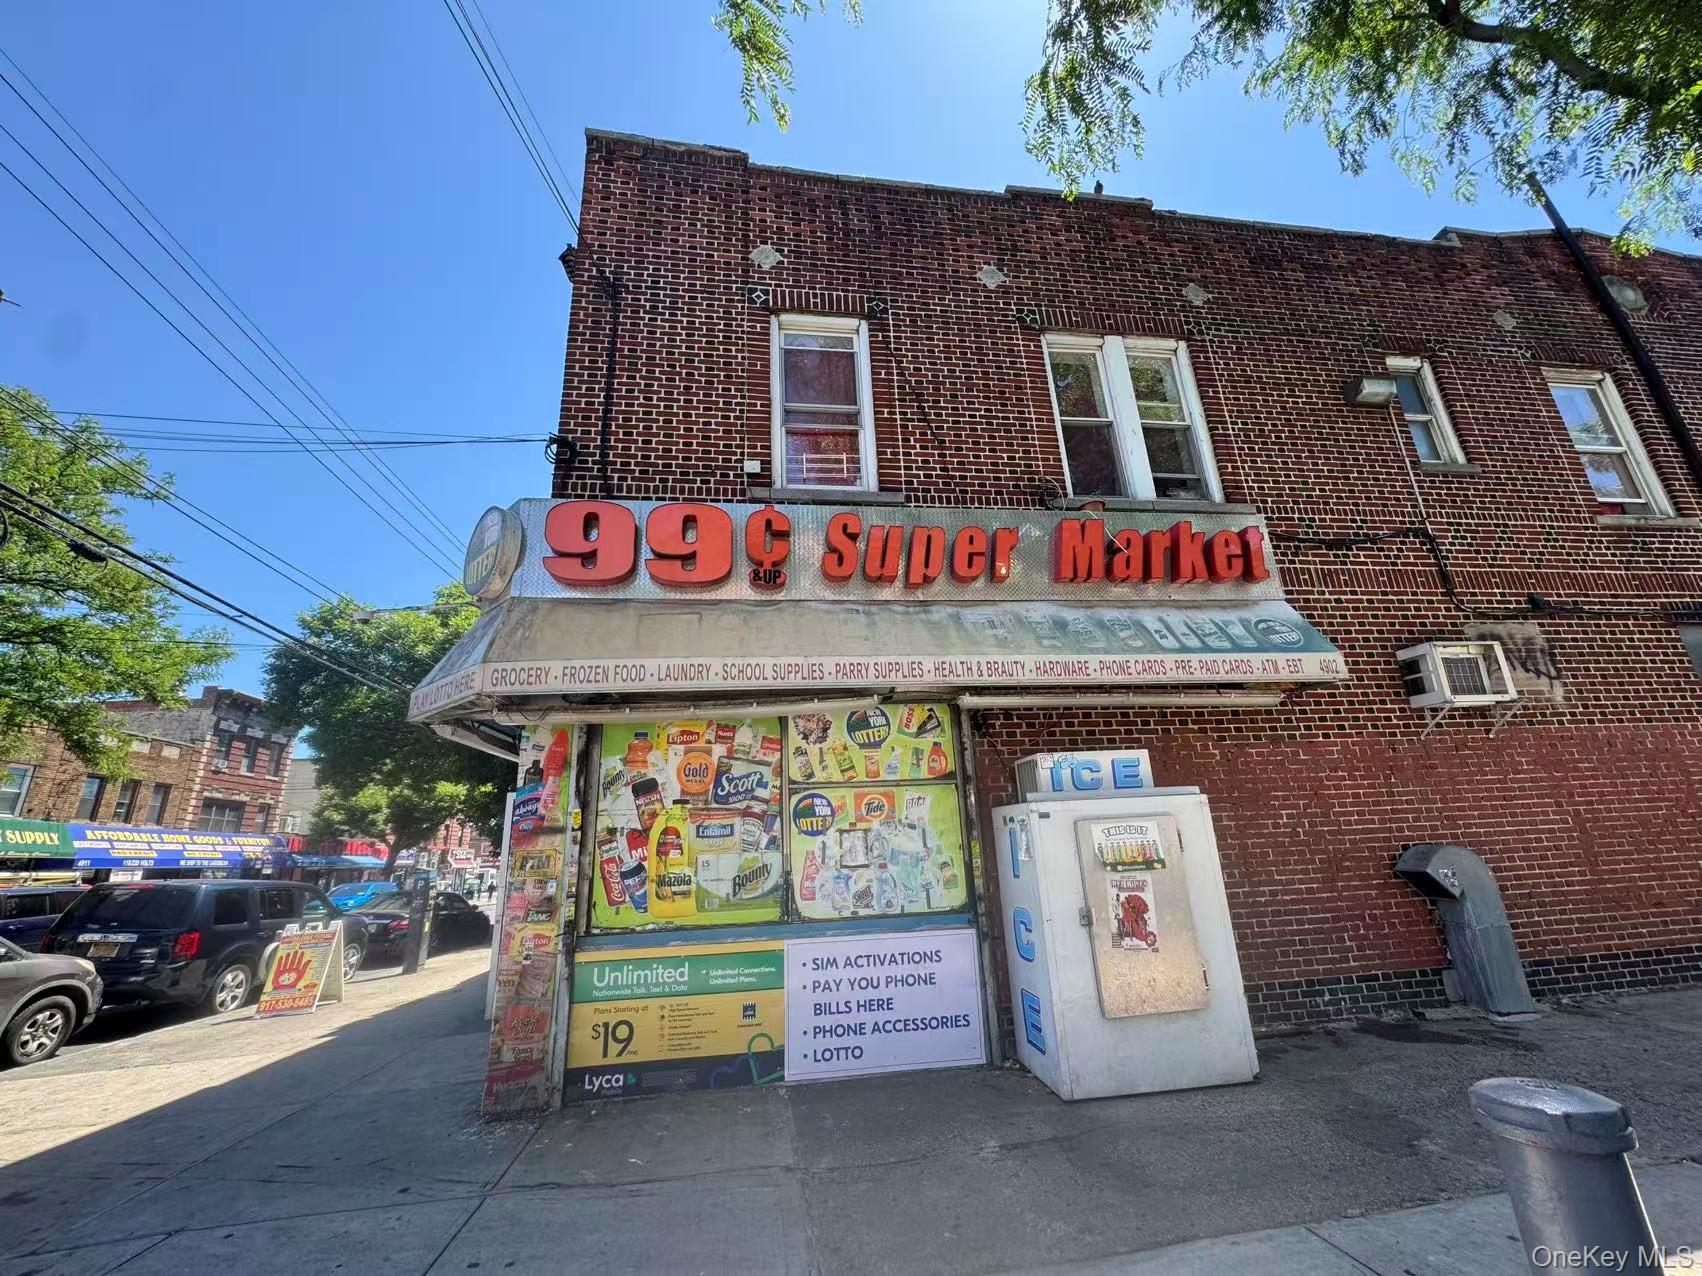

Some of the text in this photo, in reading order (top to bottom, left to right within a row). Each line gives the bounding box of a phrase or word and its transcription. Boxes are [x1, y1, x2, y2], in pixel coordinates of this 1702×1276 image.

[822, 512, 1271, 589] Super Market
[752, 568, 782, 585] &UP
[491, 666, 551, 687] GROCERY
[561, 665, 610, 684] FROZEN
[613, 664, 646, 682] FOOD
[657, 663, 712, 681] LAUNDRY
[722, 663, 768, 681] SCHOOL
[772, 662, 825, 680] SUPPLIES
[835, 662, 870, 680] PARRY
[873, 661, 924, 679] SUPPLIES
[933, 661, 973, 677] HEALTH
[976, 661, 984, 677] &
[986, 661, 1025, 677] BRAUTY
[1034, 660, 1091, 677] HARDWARE
[1099, 660, 1132, 676] PHONE
[1134, 659, 1167, 675] CARDS
[1199, 659, 1220, 675] PAID
[1222, 659, 1254, 675] CARDS
[1261, 658, 1280, 675] ATM
[1286, 658, 1305, 674] EBT
[1319, 658, 1340, 674] 4902
[429, 682, 453, 705] LOTTO
[455, 670, 476, 693] HERE
[869, 716, 887, 727] YORK
[669, 733, 698, 744] Lipton
[851, 726, 889, 743] LOTTERY
[684, 762, 709, 778] Gold
[1052, 757, 1143, 792] ICE
[717, 772, 760, 796] Scott
[814, 798, 828, 806] NEW
[864, 801, 886, 816] Tide
[815, 806, 832, 816] YORK
[6, 830, 60, 845] SUPPLY
[85, 830, 161, 842] AFFORDABLE
[161, 833, 193, 844] HOME
[193, 835, 224, 845] GOODS
[231, 837, 273, 846] FURNITUR
[699, 826, 731, 836] Enfamil
[1102, 825, 1148, 837] THIS IS IT
[656, 872, 691, 887] Mazola
[732, 862, 773, 899] Bounty
[812, 950, 943, 971] SIM ACTIVATIONS
[593, 962, 689, 987] Unlimited
[709, 968, 739, 976] Unlimited
[709, 977, 739, 985] Unlimited
[812, 972, 936, 993] PAY YOU PHONE
[592, 988, 631, 997] Nationwide
[650, 985, 663, 993] Text
[671, 984, 688, 992] Data
[594, 1007, 612, 1015] Plans
[614, 1005, 640, 1014] Starting
[813, 997, 894, 1016] BILLS HERE
[813, 1014, 971, 1039] PHONE ACCESSORIES
[591, 1020, 635, 1059] $19
[813, 1045, 864, 1063] LOTTO
[585, 1073, 625, 1092] Lyca
